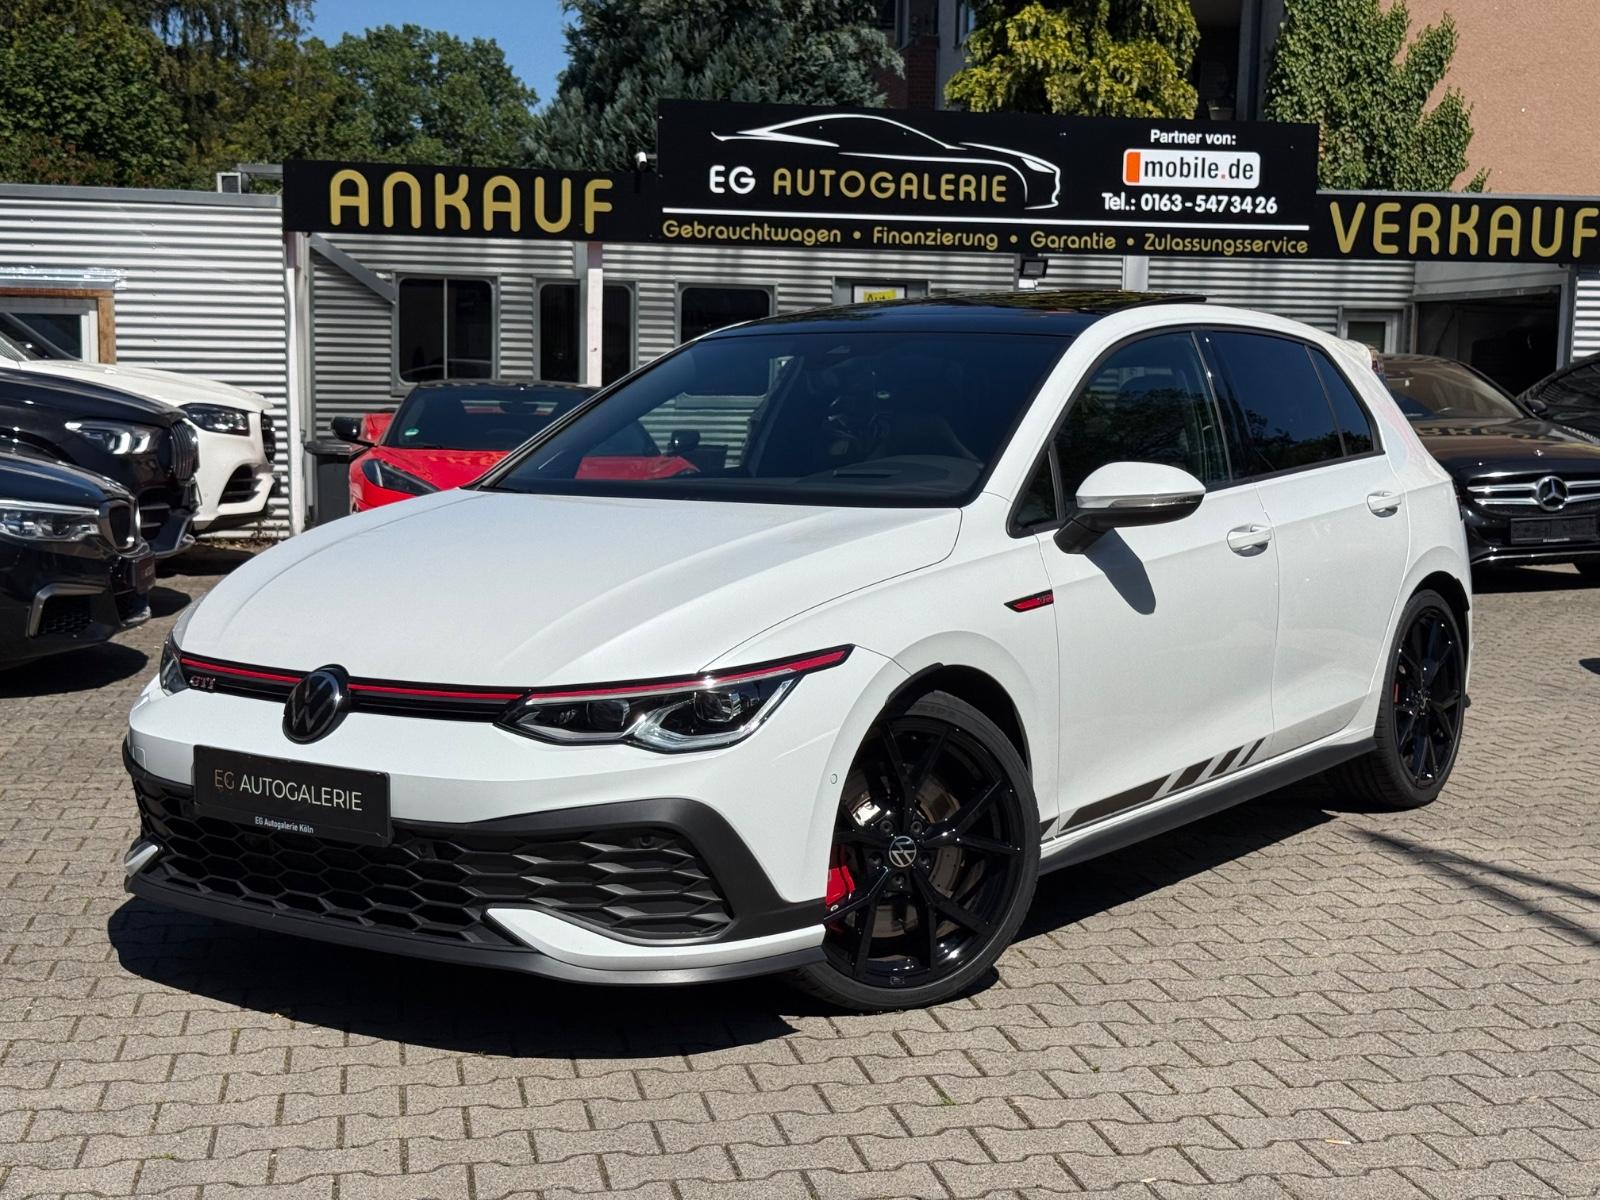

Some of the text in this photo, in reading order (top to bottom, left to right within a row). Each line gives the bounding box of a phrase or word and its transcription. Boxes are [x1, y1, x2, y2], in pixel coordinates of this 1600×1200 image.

[1151, 129, 1236, 145] Partner von:
[709, 165, 1007, 203] EG AUTOGALERIE
[1144, 157, 1254, 180] mobile.de
[330, 169, 613, 234] ANKAUF
[1101, 192, 1136, 211] Tel.:
[662, 220, 1308, 256] Gebrauchtwagen Finanzierung Garantie Zulassungsservice
[1329, 201, 1600, 258] VERKAUF
[214, 769, 362, 811] EG AUTOGALERIE
[255, 816, 314, 834] EG Autogalerie Köln
